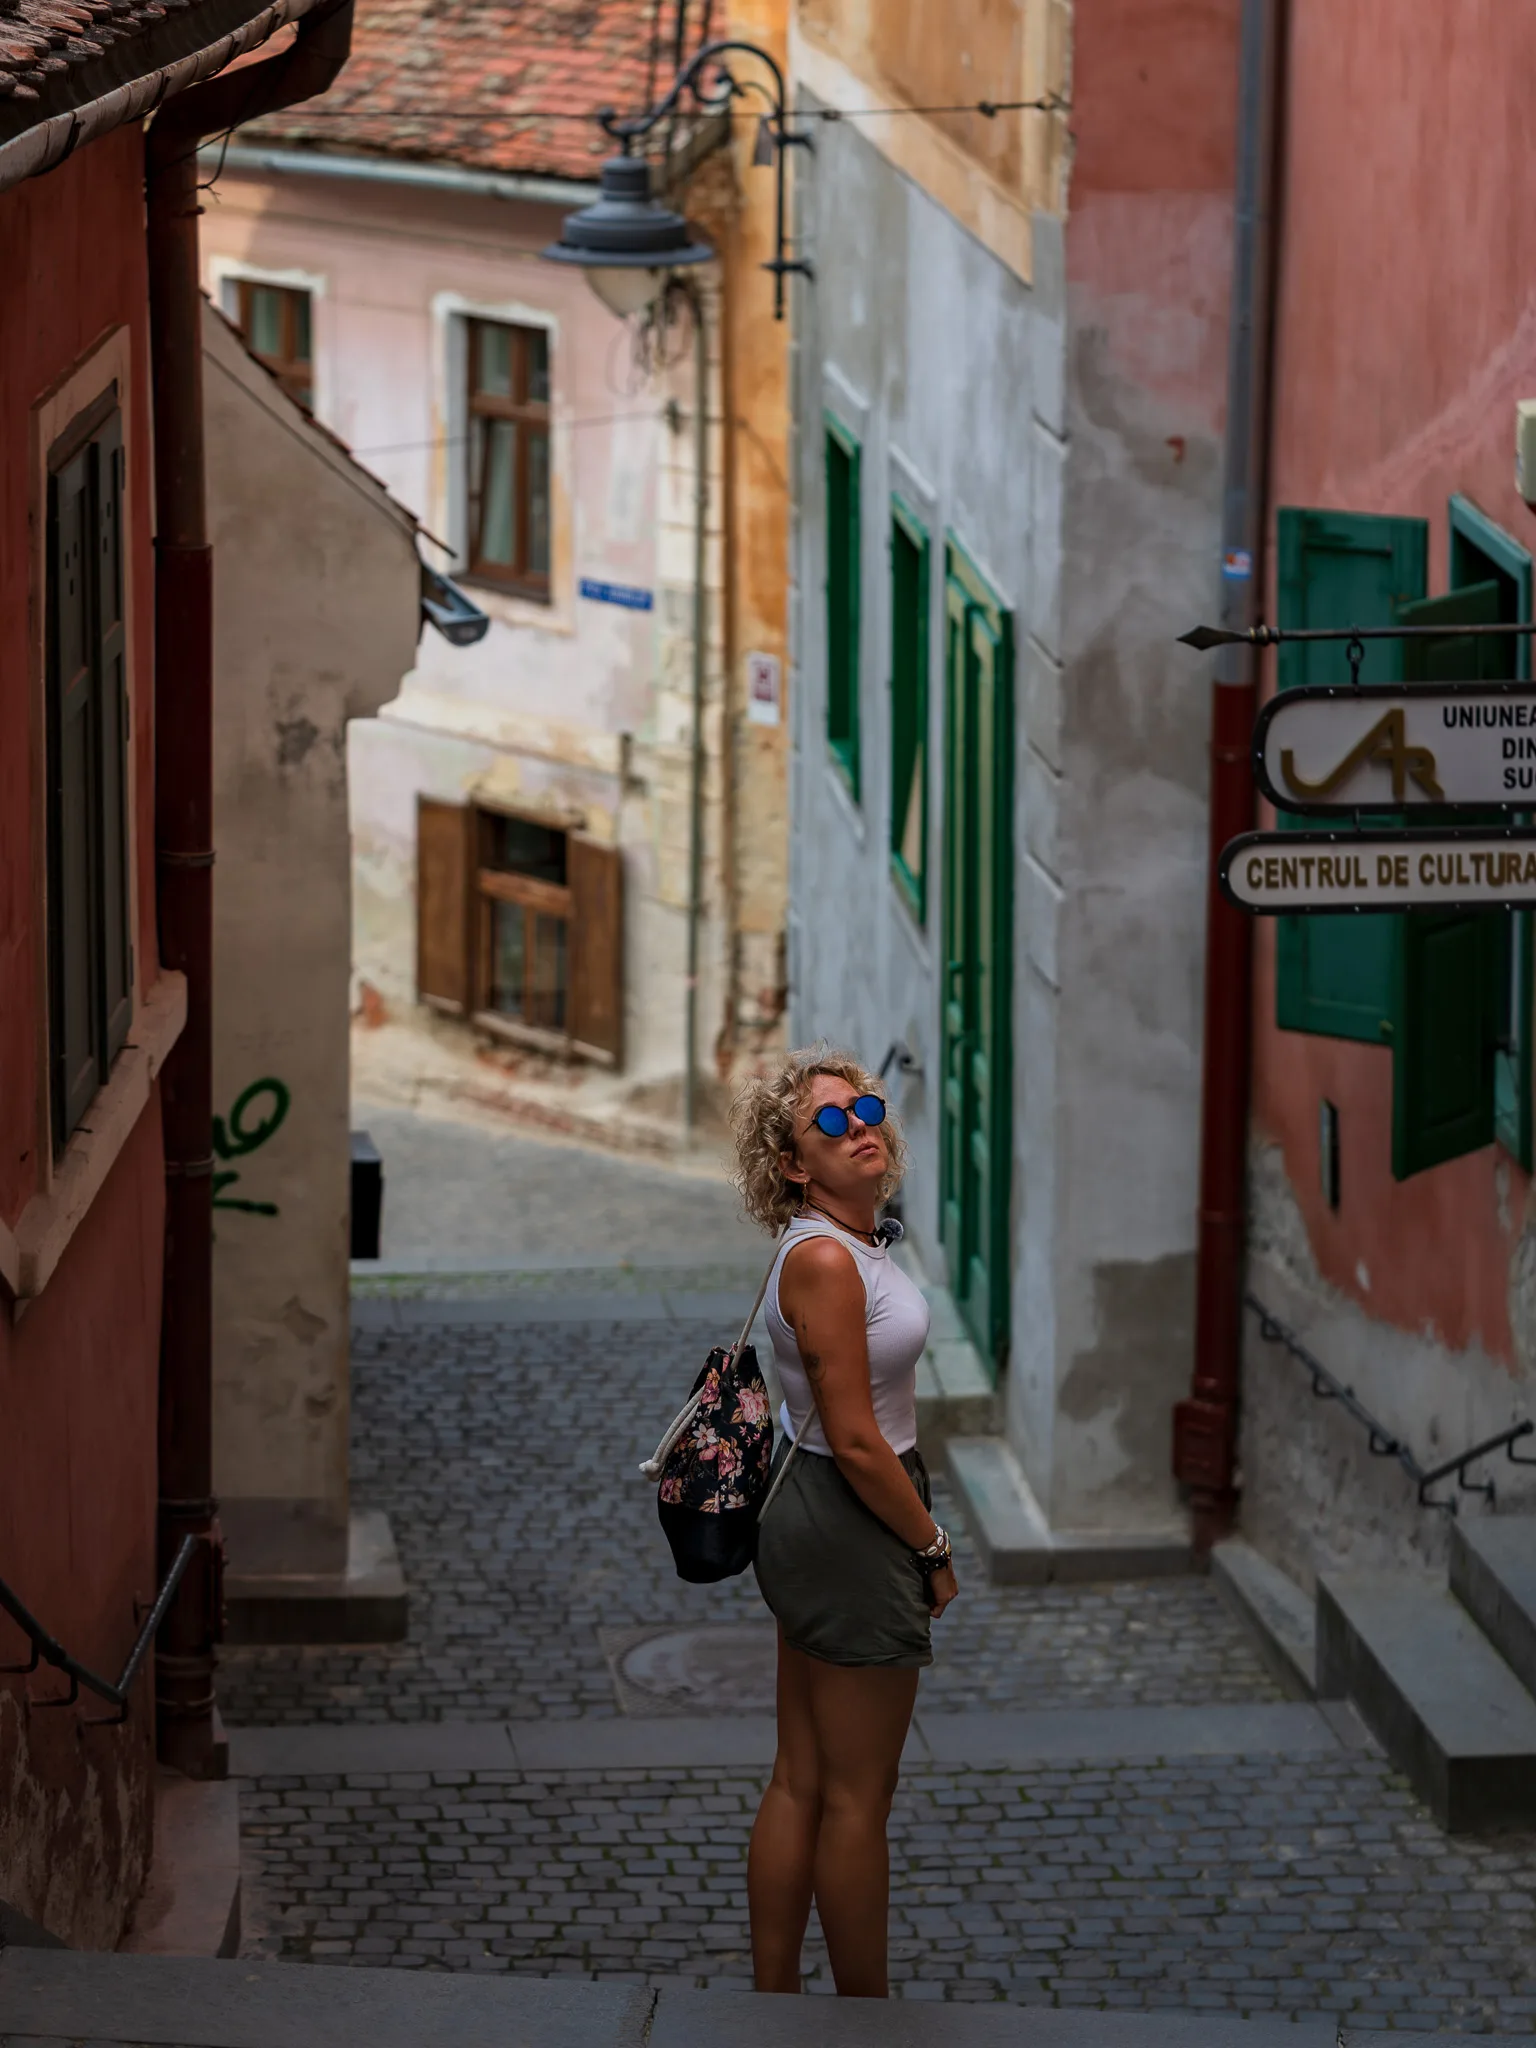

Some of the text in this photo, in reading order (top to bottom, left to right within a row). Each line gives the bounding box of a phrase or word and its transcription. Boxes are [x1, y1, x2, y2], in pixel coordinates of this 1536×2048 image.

[1503, 767, 1536, 789] SU
[1246, 852, 1536, 889] CENTRUL DE CULTURA
